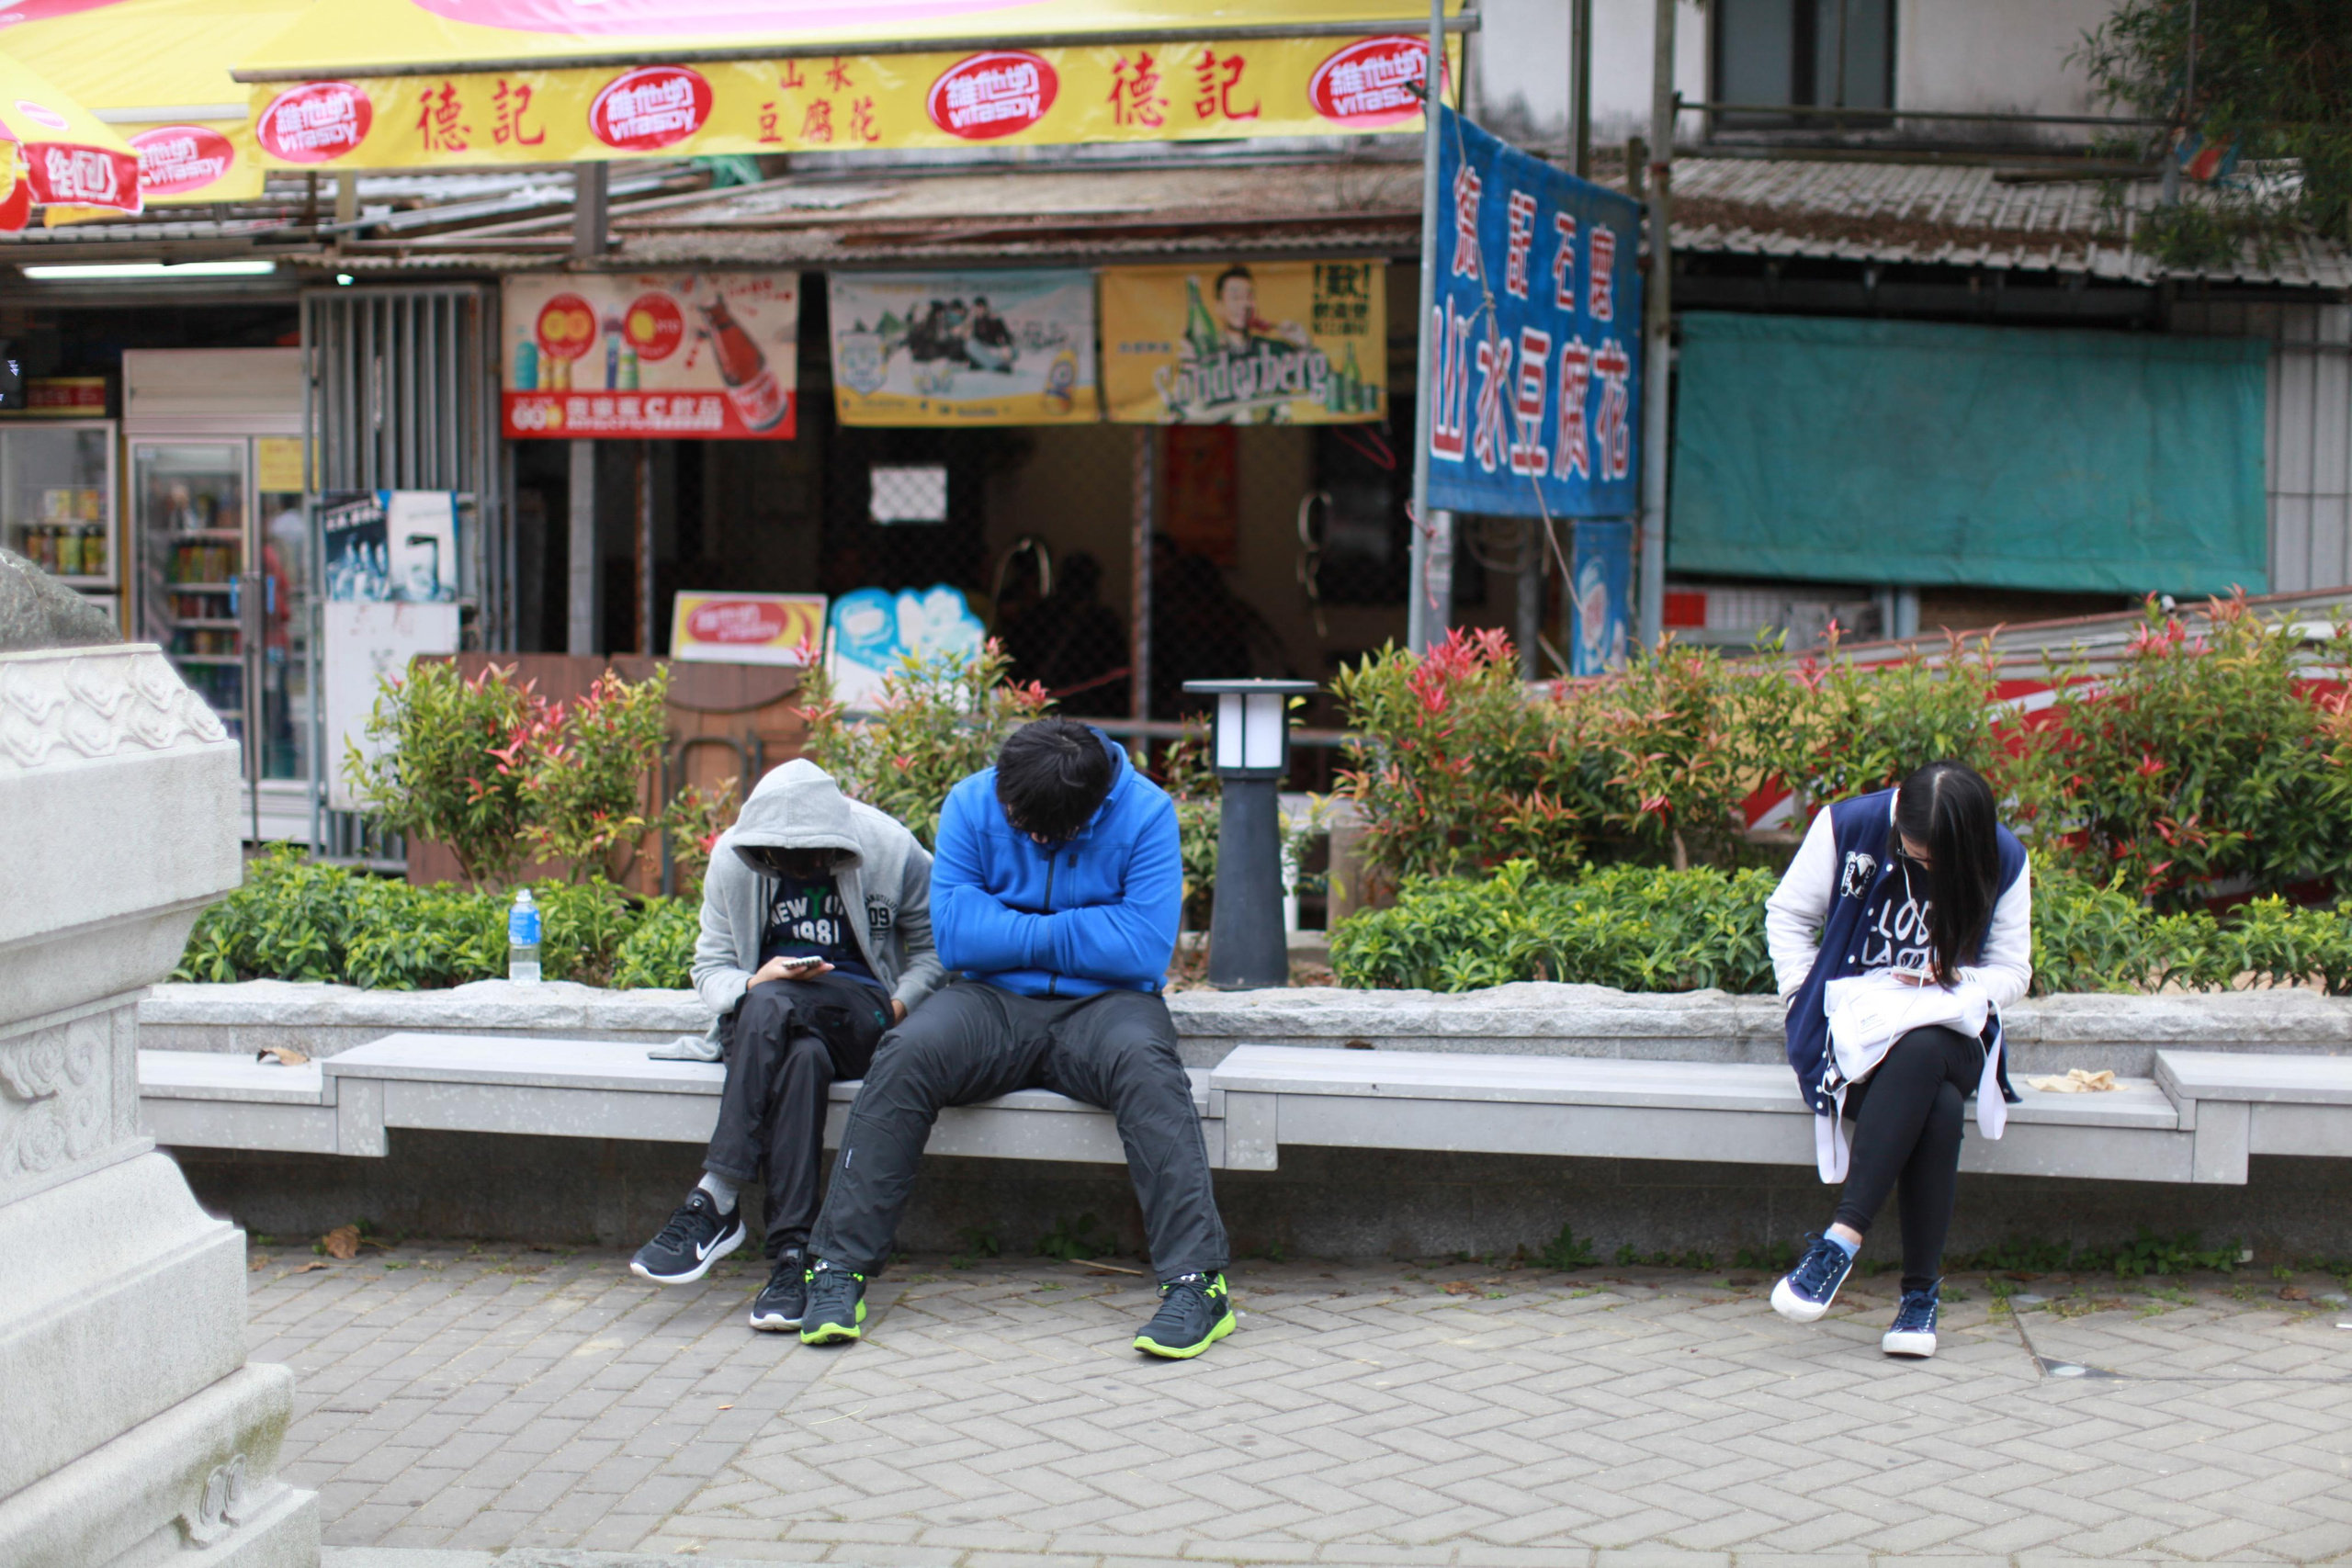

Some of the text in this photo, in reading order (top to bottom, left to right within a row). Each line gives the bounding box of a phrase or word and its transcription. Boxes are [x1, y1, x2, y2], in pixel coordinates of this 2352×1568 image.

[781, 56, 854, 91] 山水
[945, 62, 1040, 109] 維他奶
[1107, 49, 1261, 129] 德記
[275, 90, 356, 136] 維他奶
[416, 78, 545, 152] 德記
[606, 76, 695, 122] 維他奶
[758, 96, 881, 144] 豆腐花
[1430, 293, 1631, 482] 山水豆腐花
[868, 907, 890, 927] 09
